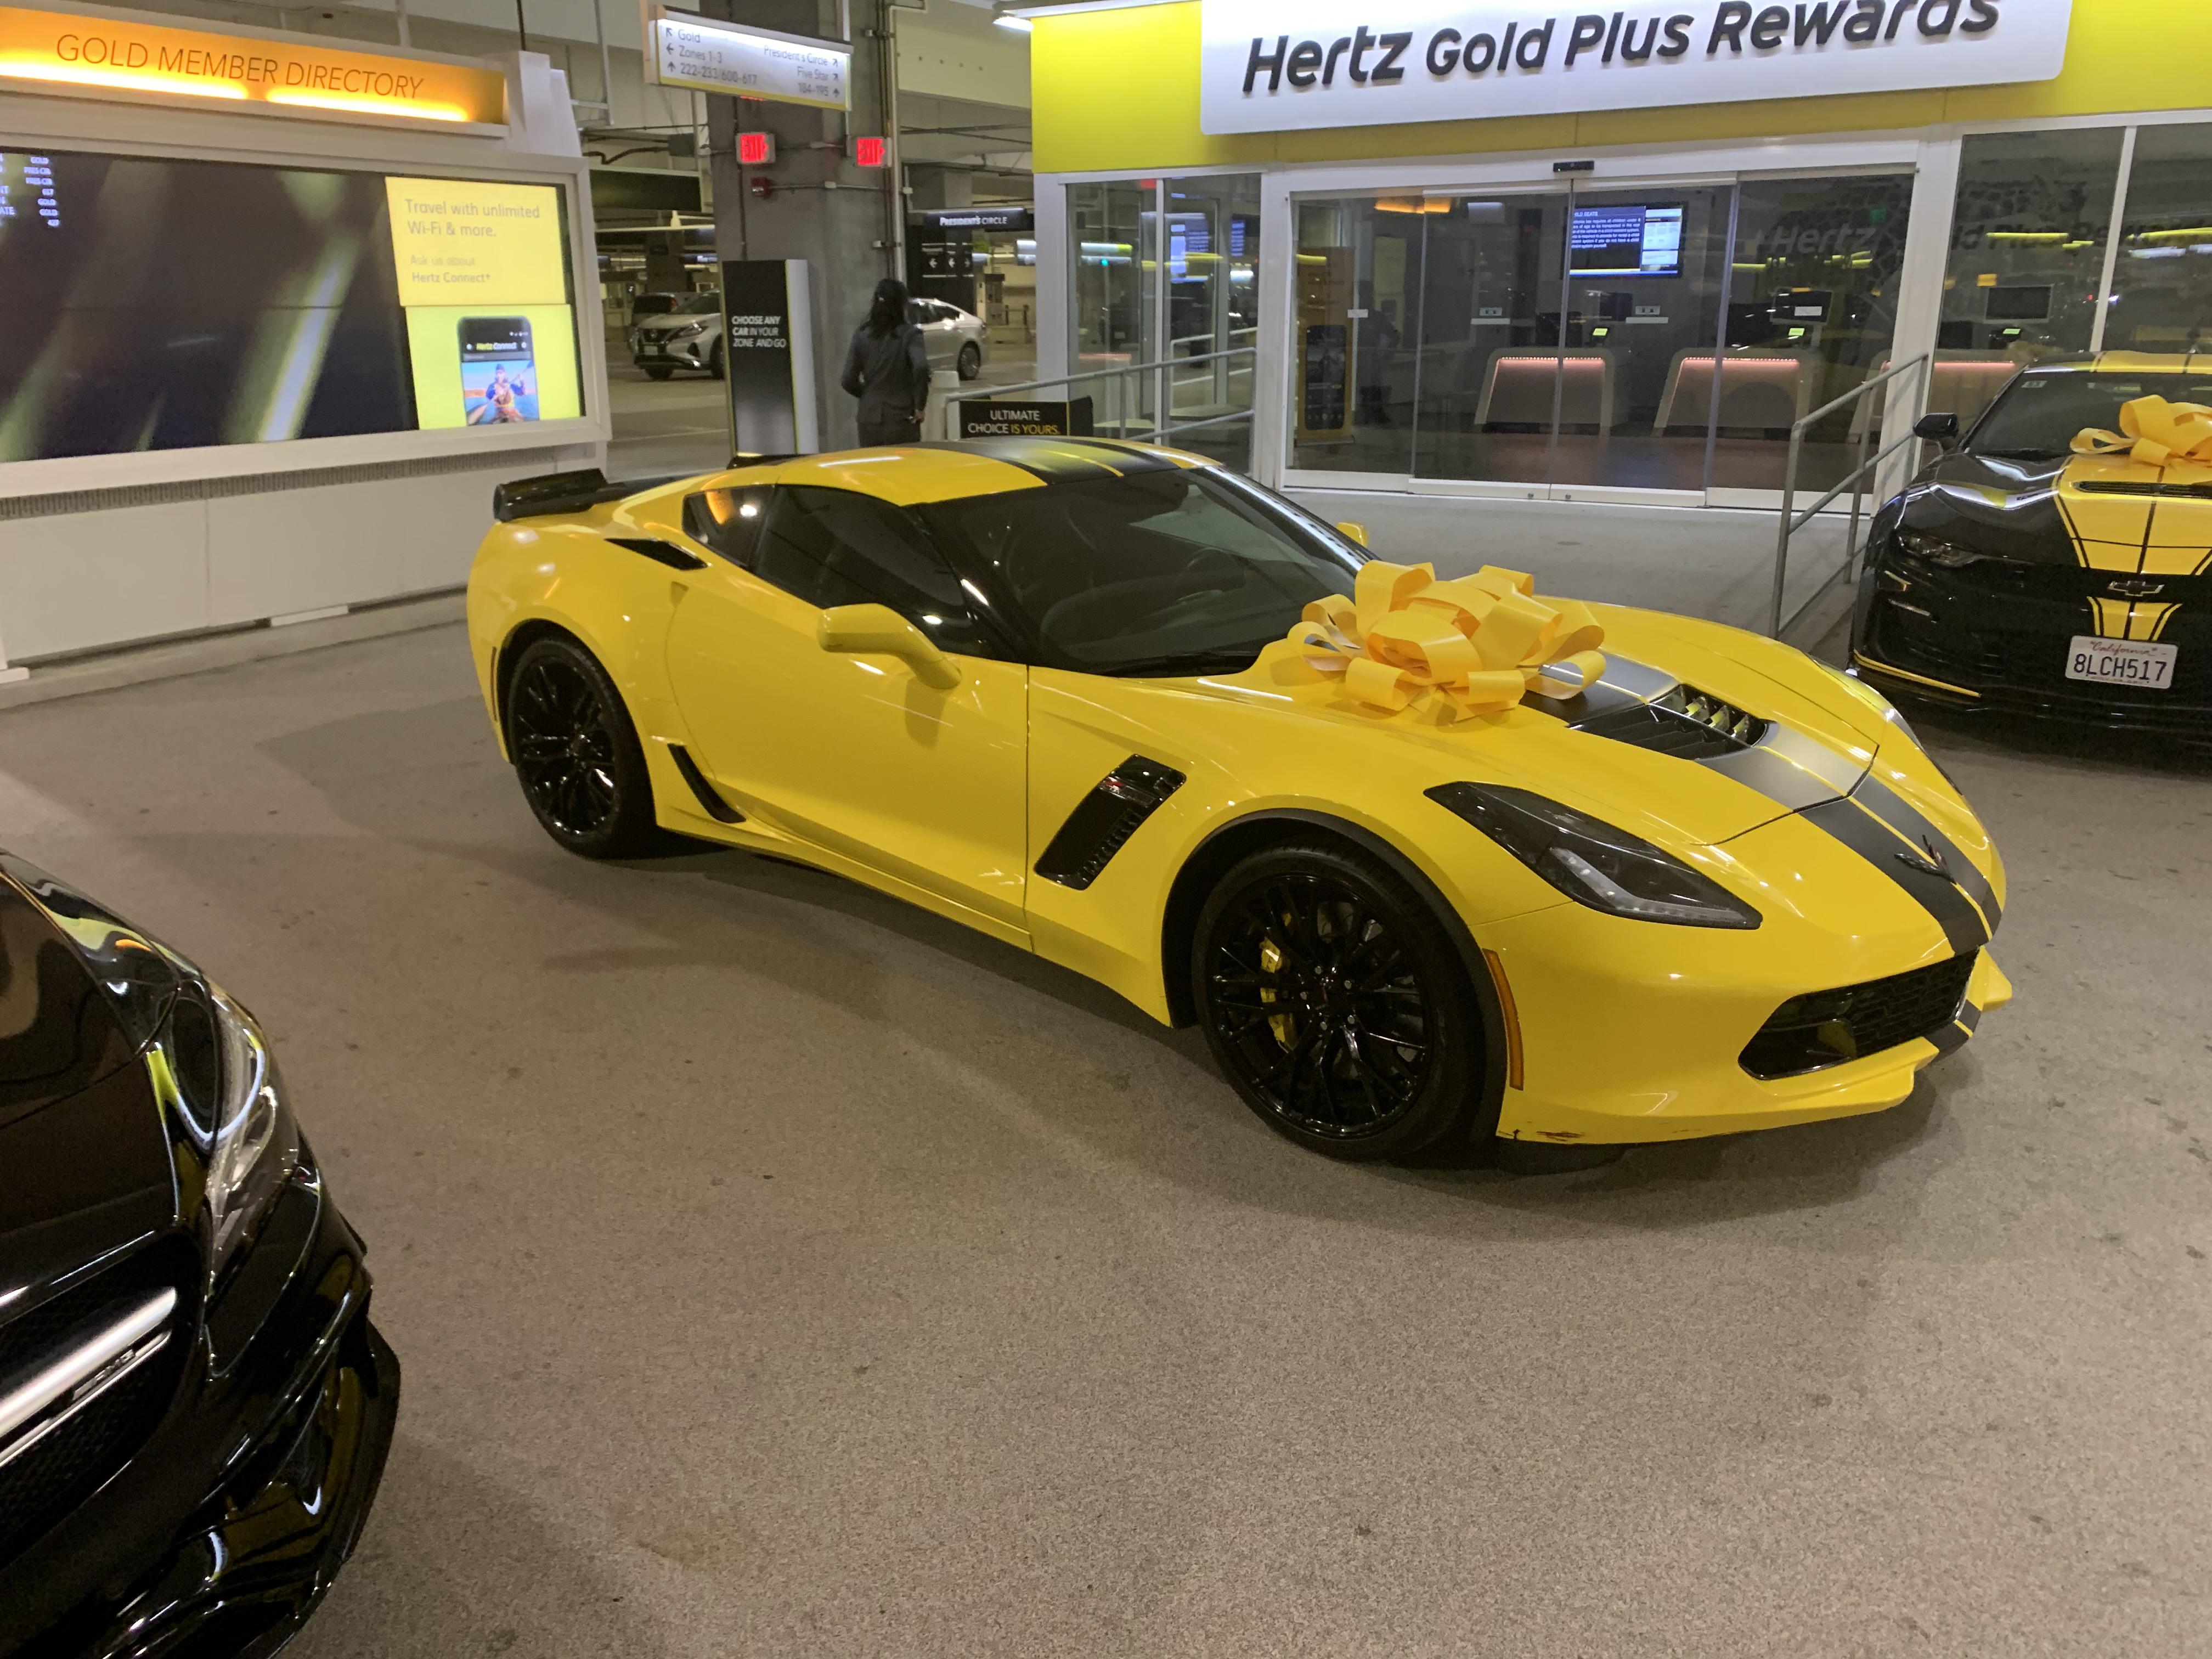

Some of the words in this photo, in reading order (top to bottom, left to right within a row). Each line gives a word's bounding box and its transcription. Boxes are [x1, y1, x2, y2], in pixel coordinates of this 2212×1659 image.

[678, 29, 701, 43] Gold
[679, 44, 706, 61] Zones
[1243, 25, 1413, 93] Hertz
[1426, 18, 1556, 76] Gold
[1565, 11, 1694, 66] Plus
[1706, 0, 2000, 54] Rewards
[57, 33, 148, 68] GOLD
[157, 46, 278, 83] MEMBER
[285, 61, 424, 99] DIRECTORY
[807, 53, 828, 66] Circle
[797, 66, 812, 78] Five
[405, 199, 447, 215] Travel
[451, 202, 479, 216] with
[483, 203, 540, 218] unlimited
[981, 216, 1008, 224] CIRCLE
[408, 221, 442, 235] Wi-Fi
[446, 222, 456, 236] &
[460, 225, 496, 237] more.
[410, 255, 427, 266] Ask
[432, 257, 444, 266] us
[446, 256, 475, 267] about
[412, 272, 440, 283] Hertz
[731, 315, 763, 325] CHOOSE
[764, 315, 781, 325] ANY
[732, 327, 748, 336] CAR
[758, 326, 779, 336] YOUR
[733, 338, 754, 347] ZONE
[755, 338, 773, 348] AND
[774, 338, 787, 348] GO
[989, 410, 1041, 421] ULTIMATE
[967, 422, 1009, 434] CHOICE
[1011, 424, 1020, 434] IS
[1022, 424, 1060, 435] YOURS.
[2073, 653, 2167, 682] 8LCH517
